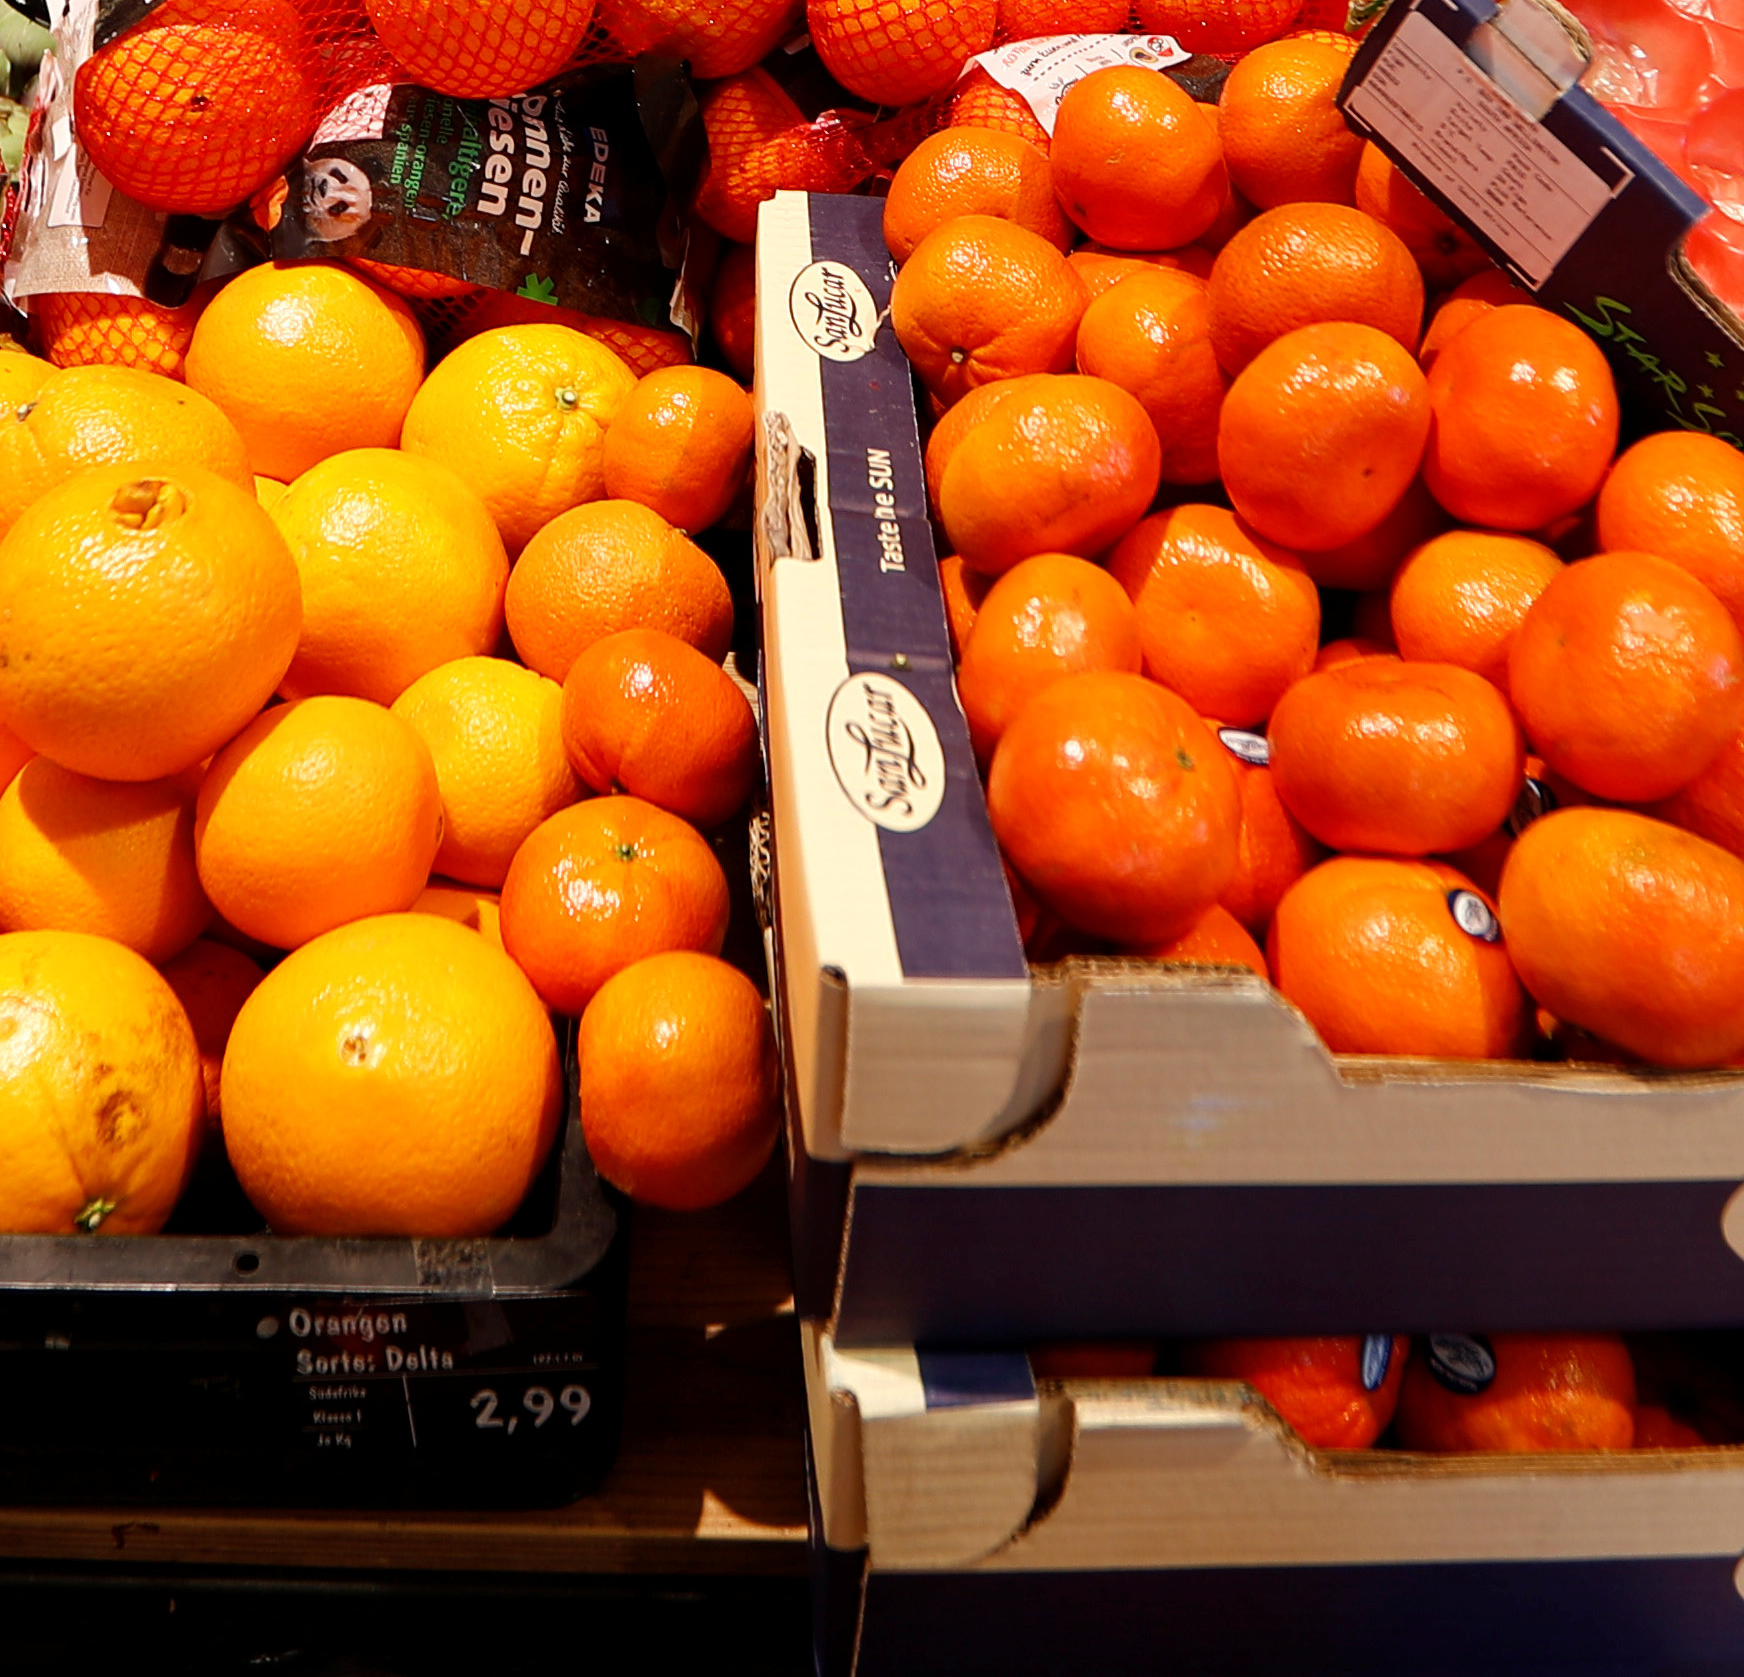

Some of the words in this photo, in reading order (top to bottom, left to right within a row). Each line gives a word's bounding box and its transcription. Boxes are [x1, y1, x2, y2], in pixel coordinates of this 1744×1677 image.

[389, 121, 413, 185] spanien
[476, 97, 518, 216] iesen
[514, 94, 552, 257] onnen-
[582, 125, 610, 224] EDEKA
[804, 265, 864, 355] SanLucar
[867, 448, 892, 491] SUN
[878, 516, 908, 575] Taste
[843, 680, 928, 817] SanLucar
[289, 1307, 407, 1343] Orangen
[296, 1349, 375, 1375] Sorte:
[385, 1345, 454, 1373] Delta
[308, 1385, 367, 1402] Südafrika
[312, 1409, 352, 1425] Klasse
[469, 1384, 591, 1435] 2,99
